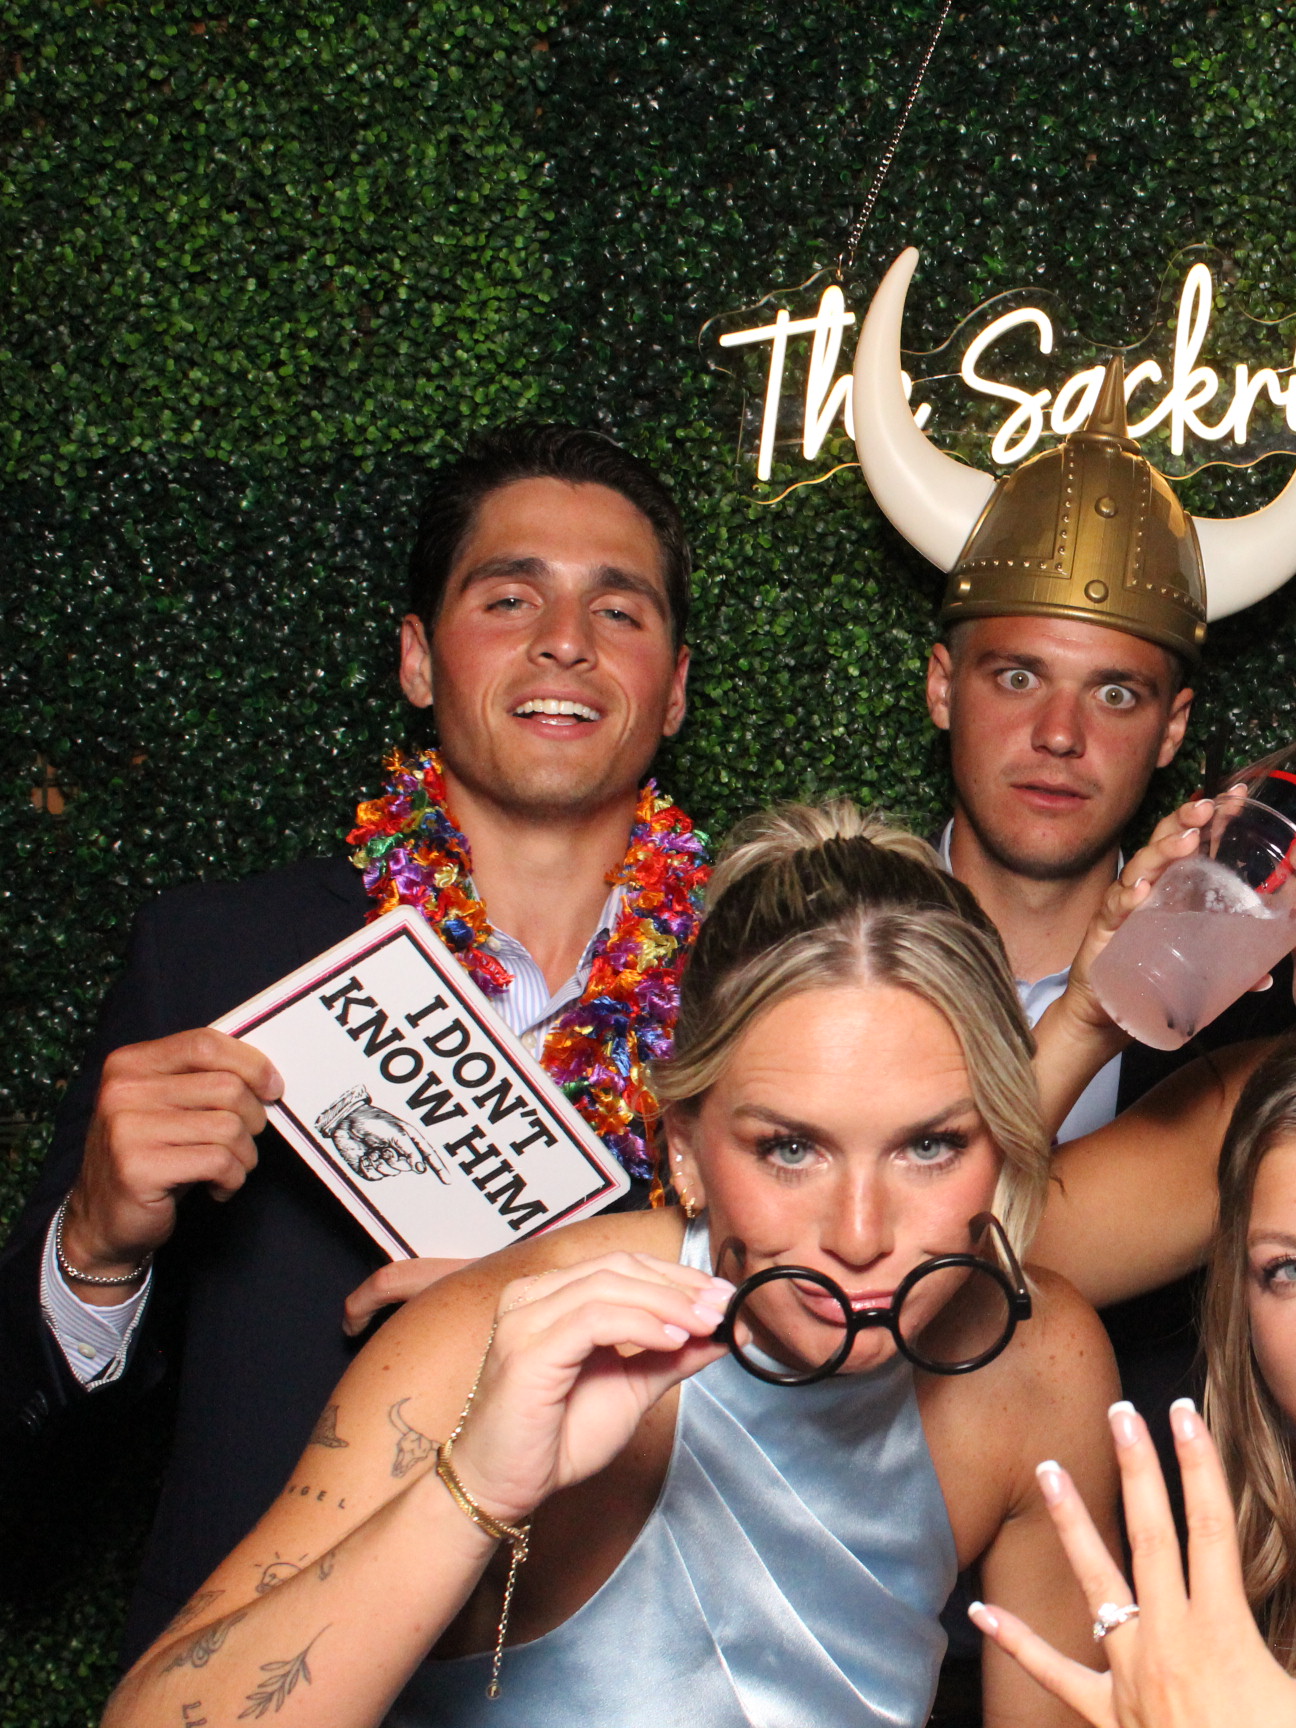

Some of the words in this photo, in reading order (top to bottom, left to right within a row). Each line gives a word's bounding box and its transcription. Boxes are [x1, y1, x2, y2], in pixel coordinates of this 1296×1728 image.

[404, 994, 450, 1029] I
[319, 976, 468, 1128] KNOW
[443, 1125, 549, 1232] HIM
[424, 1018, 558, 1156] DON'T
